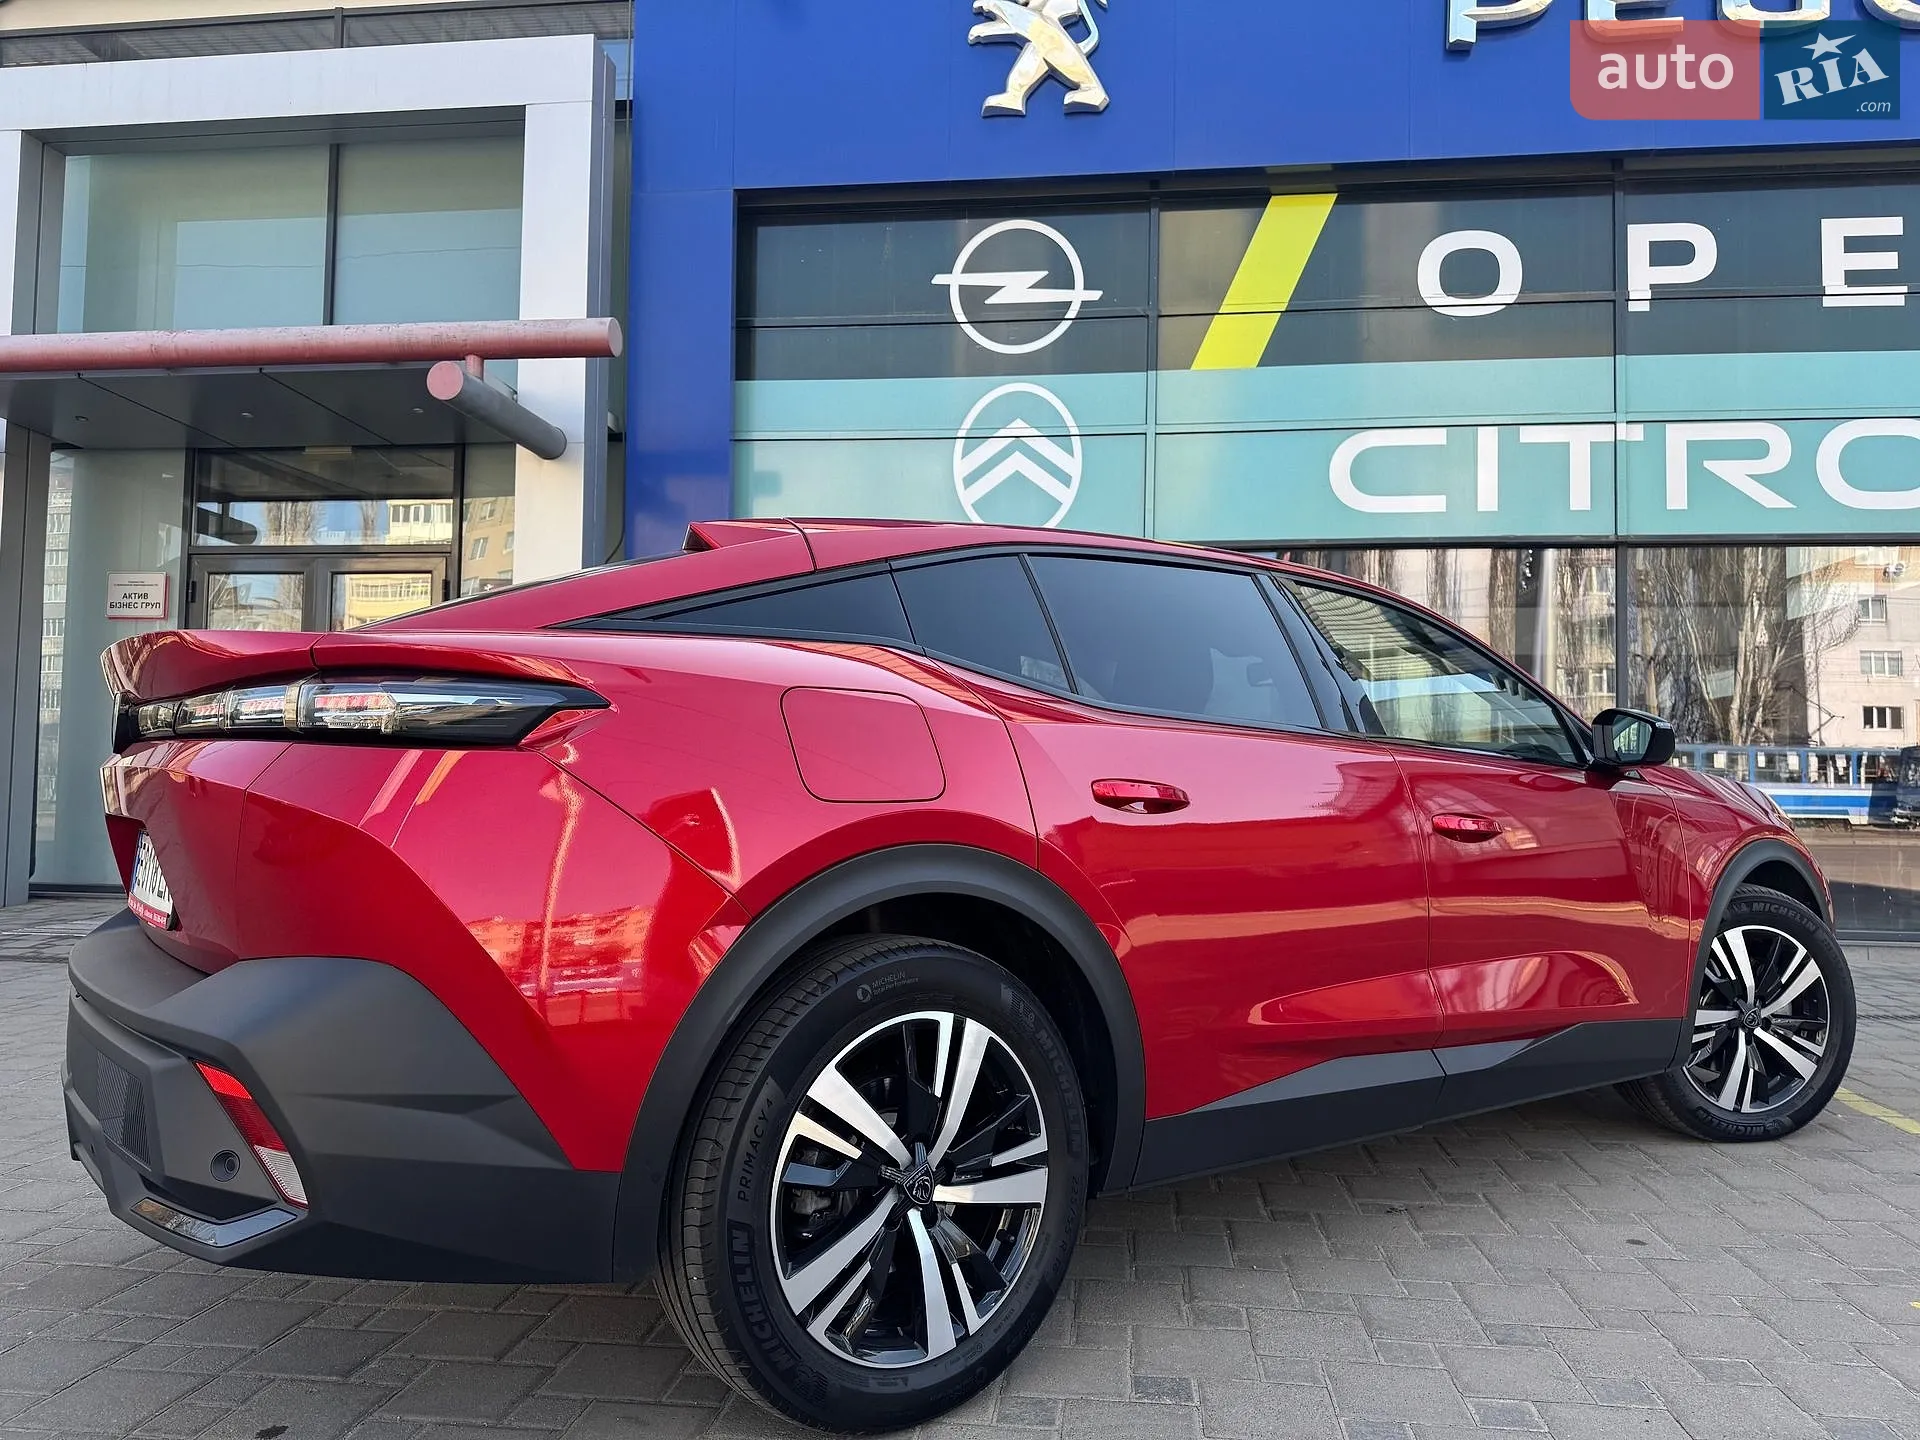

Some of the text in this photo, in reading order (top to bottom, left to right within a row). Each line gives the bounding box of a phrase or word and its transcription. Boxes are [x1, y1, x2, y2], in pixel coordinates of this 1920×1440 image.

[1416, 216, 1908, 318] OPE
[1328, 418, 1920, 513] CITRO
[121, 592, 149, 600] АКТИВ
[1751, 902, 1817, 932] MICHELIN
[1035, 1028, 1084, 1152] MICHELIN
[739, 1110, 769, 1202] PRIMACY
[732, 1229, 796, 1373] MICHELIN
